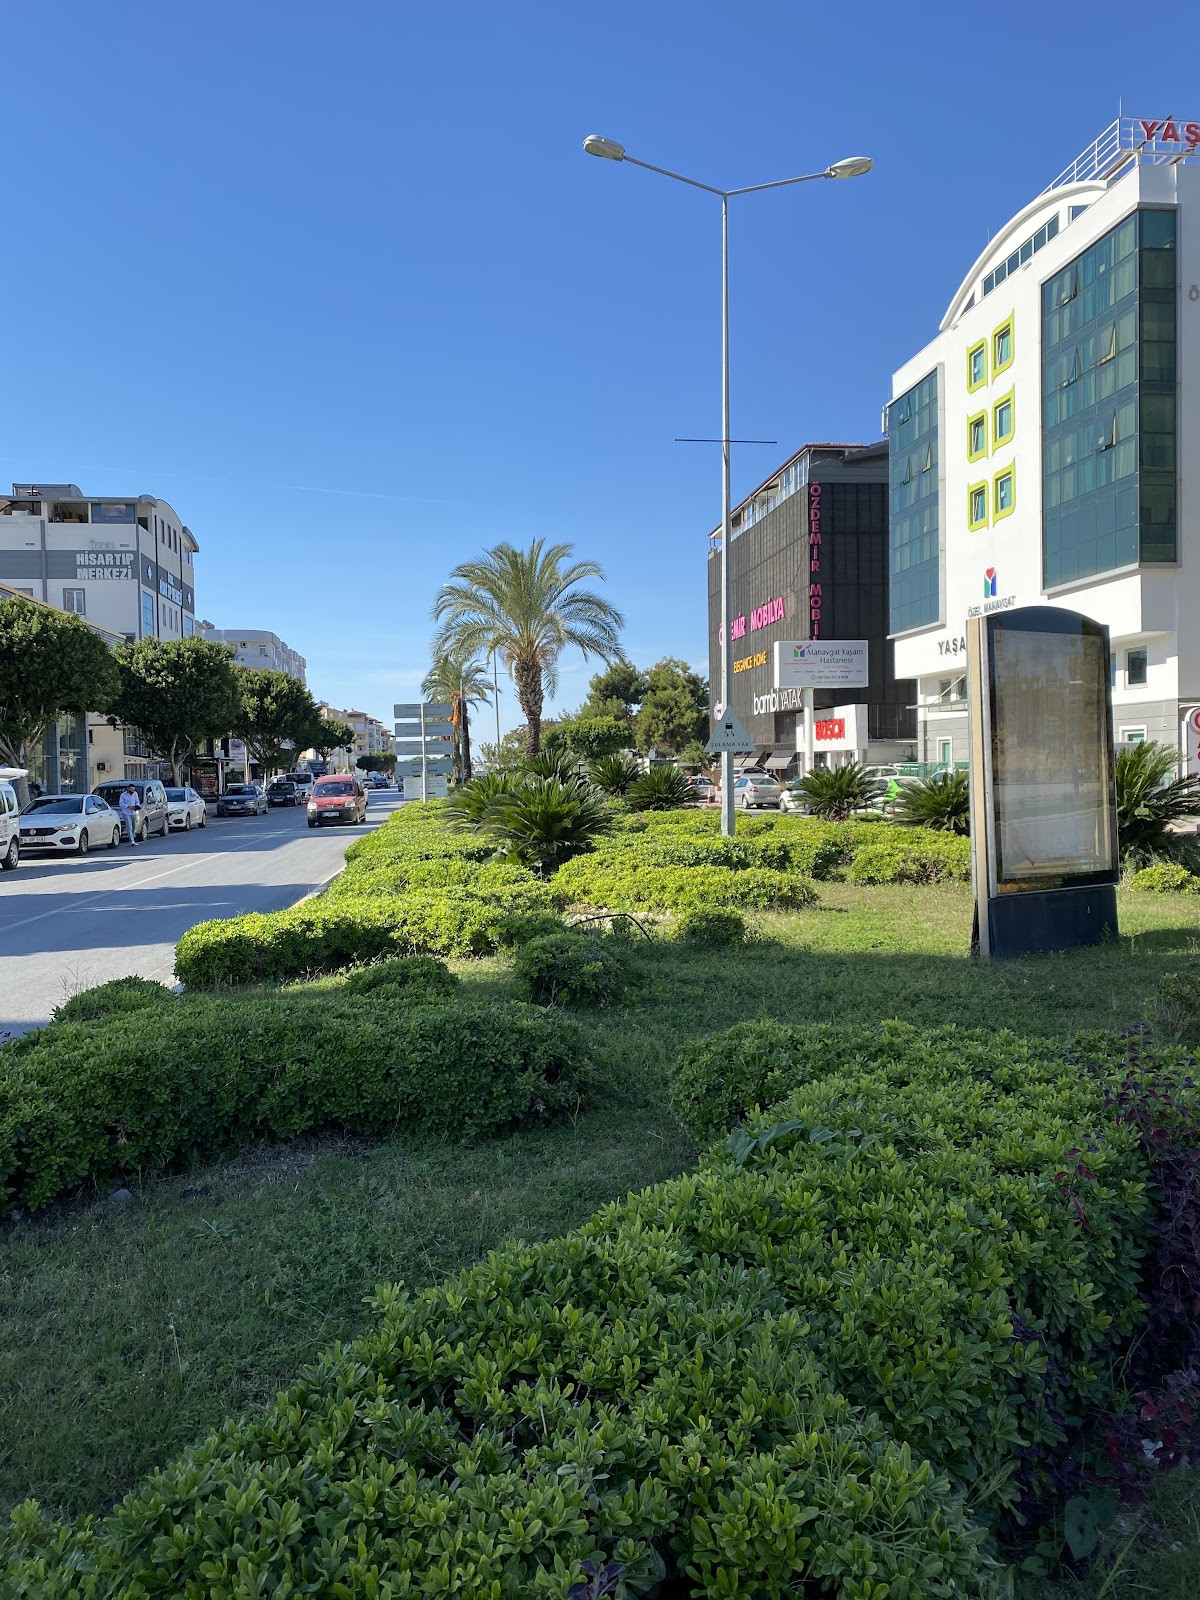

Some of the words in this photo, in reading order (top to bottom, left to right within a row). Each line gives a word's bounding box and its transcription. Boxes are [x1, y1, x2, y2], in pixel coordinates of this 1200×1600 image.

[810, 482, 822, 572] ÖZDEMİR
[76, 566, 132, 580] MERKEZİ
[750, 596, 784, 632] MOBİLYA
[810, 584, 822, 641] MOBİ
[753, 651, 767, 668] HOME
[807, 648, 840, 657] Manavgat
[841, 648, 864, 657] Yaşam
[820, 656, 853, 664] Hastanesi
[753, 687, 780, 716] bambi
[780, 688, 802, 709] YATAK
[815, 717, 845, 741] BOSCH
